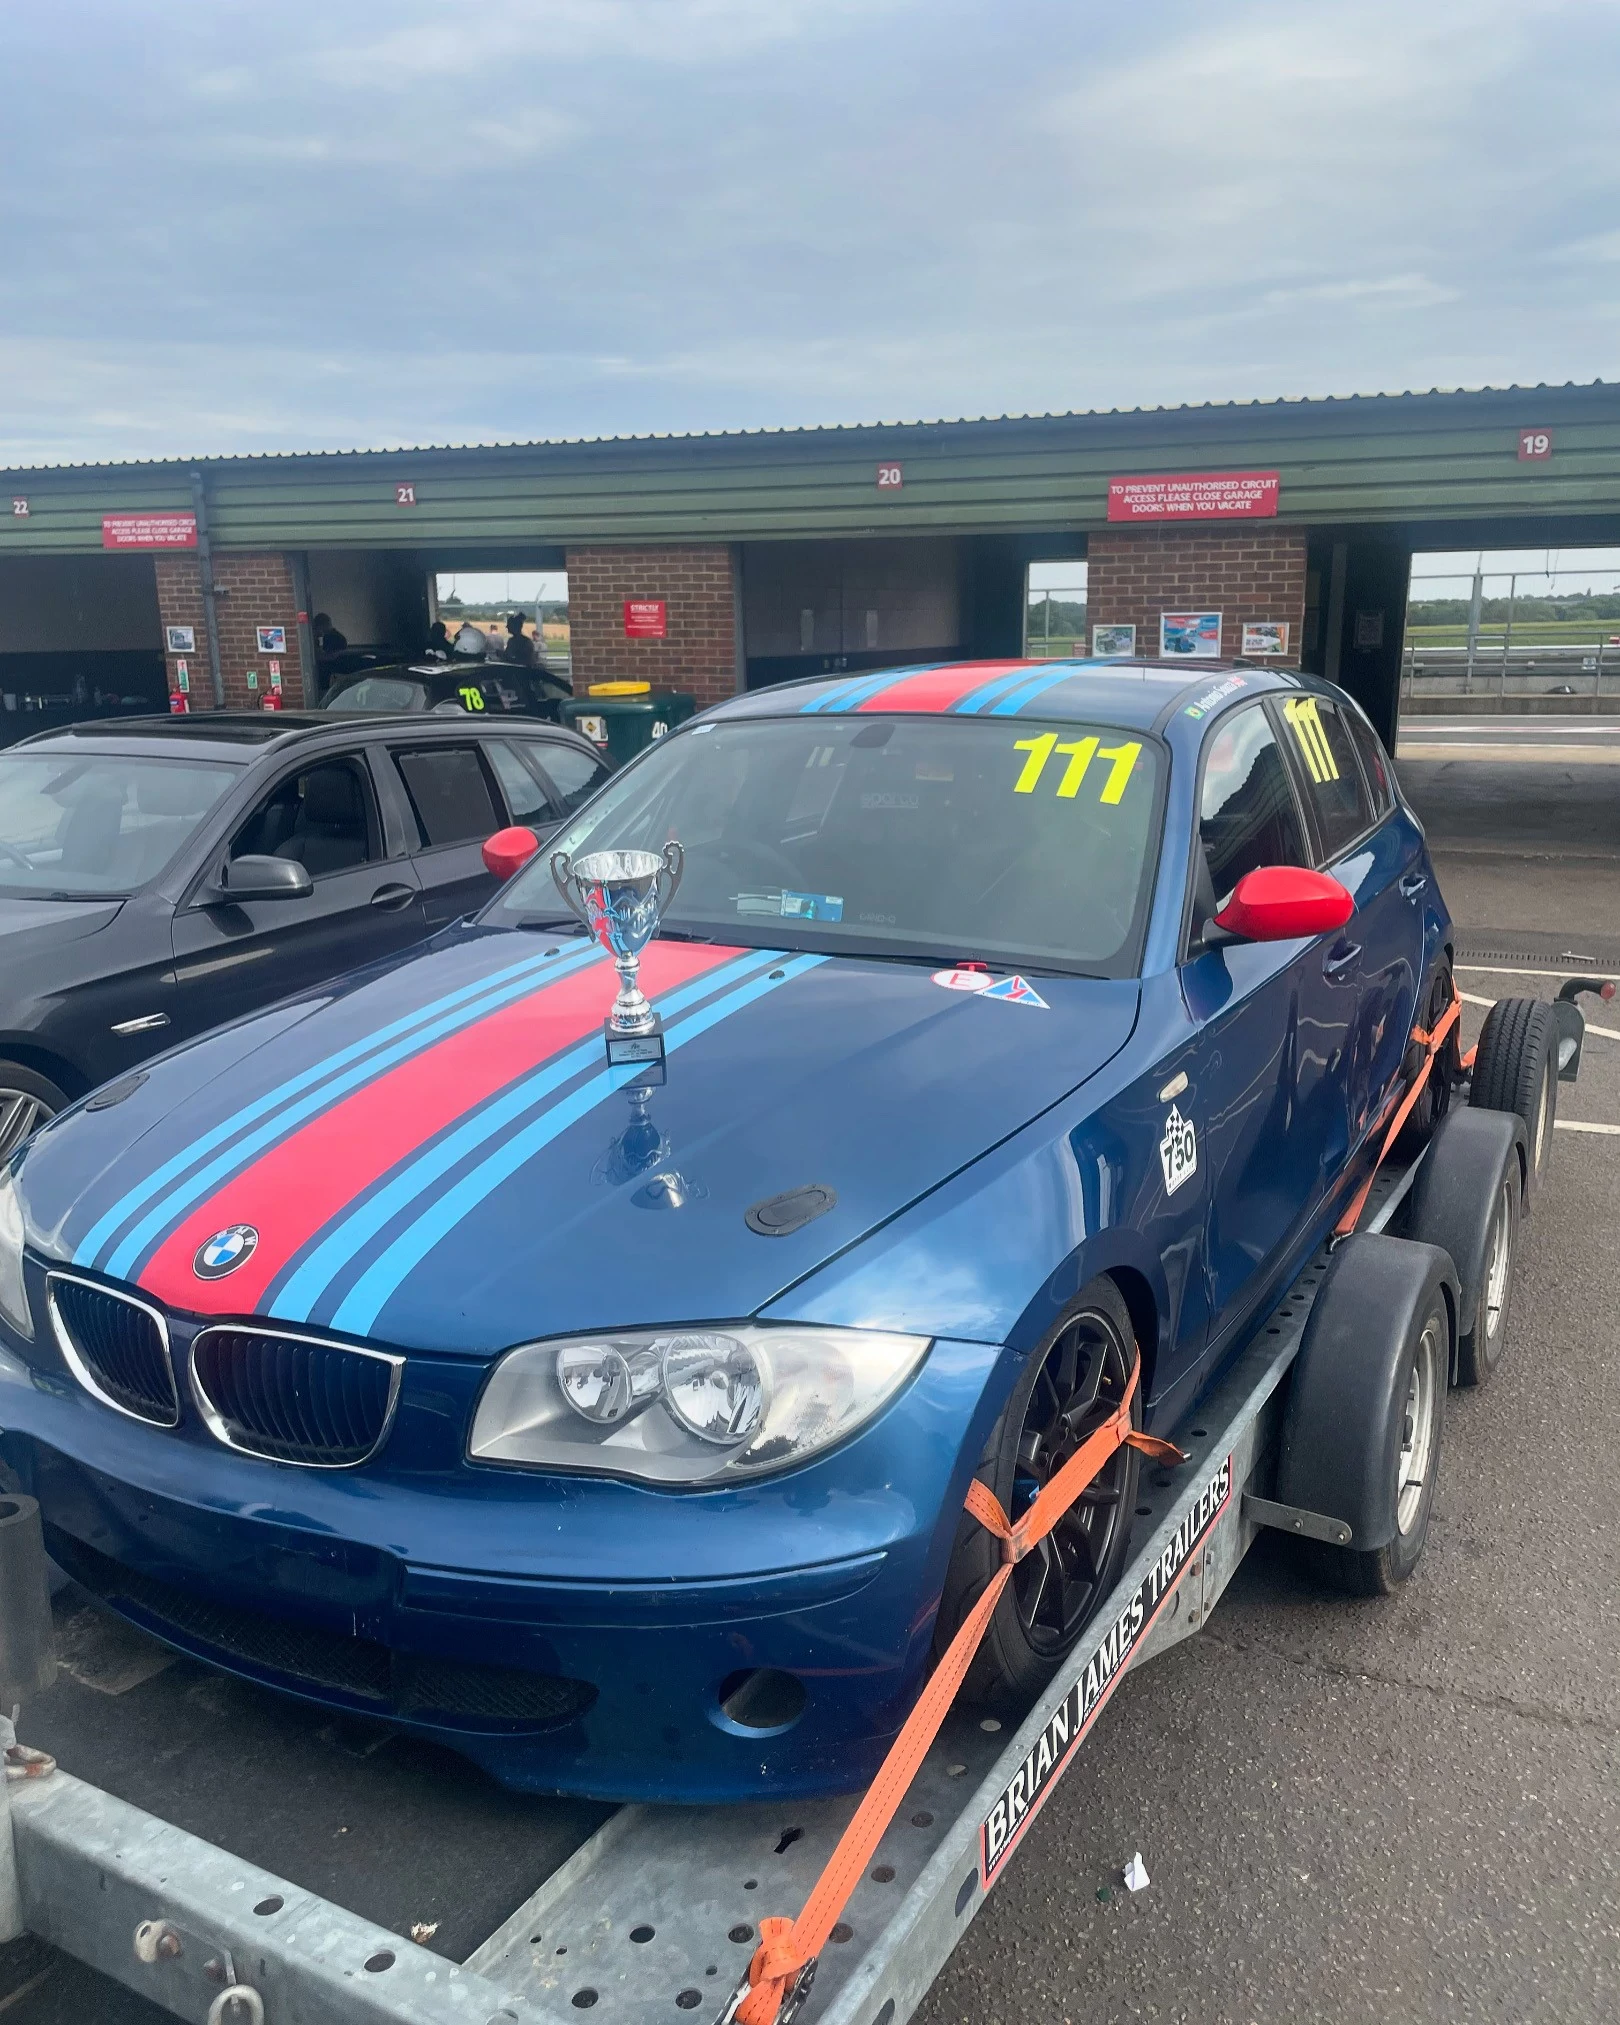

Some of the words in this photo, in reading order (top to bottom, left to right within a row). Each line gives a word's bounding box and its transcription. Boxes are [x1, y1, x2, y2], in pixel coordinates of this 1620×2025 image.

[1523, 434, 1549, 454] 19
[878, 468, 901, 485] 20
[398, 487, 414, 503] 21
[1111, 485, 1124, 495] TO
[1125, 484, 1166, 494] PREVENT
[1167, 481, 1239, 492] UNAUTHORISED
[1241, 479, 1278, 489] CIRCUIT
[1123, 494, 1156, 504] ACCESS
[1157, 492, 1191, 502] PLEASE
[1192, 491, 1222, 501] CLOSE
[1223, 489, 1263, 500] GARAGE
[13, 500, 29, 514] 22
[1132, 503, 1165, 513] DOORS
[1166, 502, 1194, 512] WHEN
[1196, 501, 1216, 511] YOU
[1217, 500, 1252, 510] VACATE
[459, 687, 485, 711] 78
[1283, 698, 1340, 783] 111
[1013, 732, 1142, 805] 111
[949, 972, 976, 988] E
[1164, 1130, 1194, 1180] 750
[216, 1226, 256, 1246] BMW
[986, 1697, 1070, 1864] BRIAN
[1073, 1586, 1144, 1736] JAMES
[1148, 1457, 1230, 1606] TRAILERS
